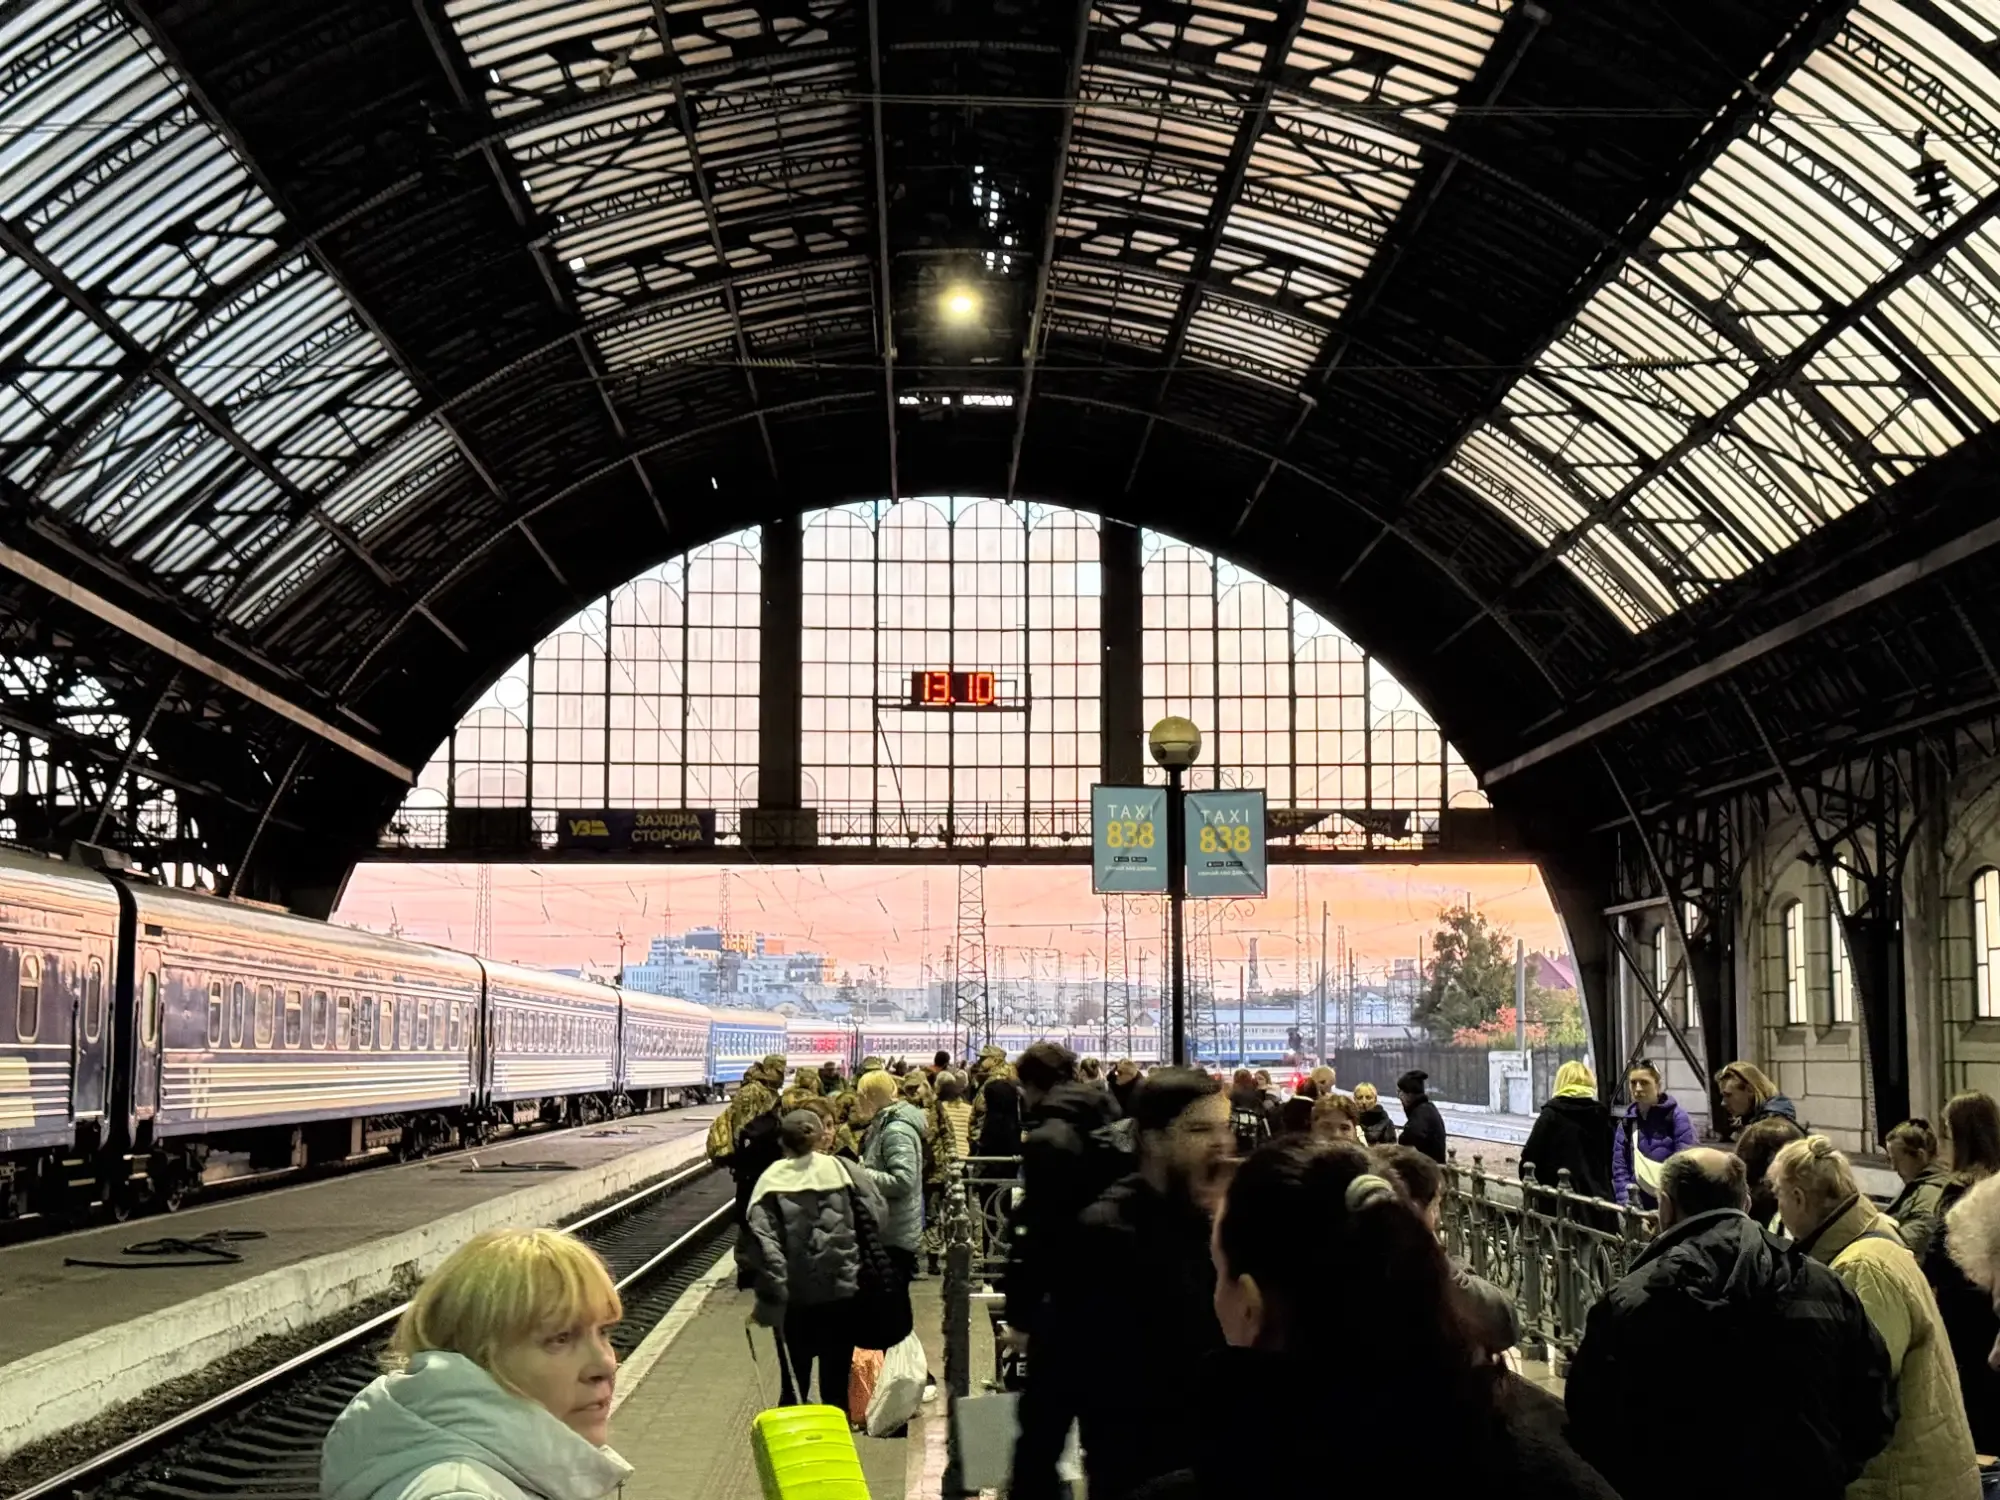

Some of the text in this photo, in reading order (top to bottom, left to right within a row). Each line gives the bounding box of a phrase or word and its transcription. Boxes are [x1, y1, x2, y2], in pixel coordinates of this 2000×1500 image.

[1107, 804, 1154, 820] TAXI
[1200, 808, 1249, 824] TAXI
[635, 814, 700, 827] ЗАХІДНА
[632, 829, 703, 842] СТОРОНА
[1106, 821, 1155, 848] 838
[1200, 825, 1251, 853] 838
